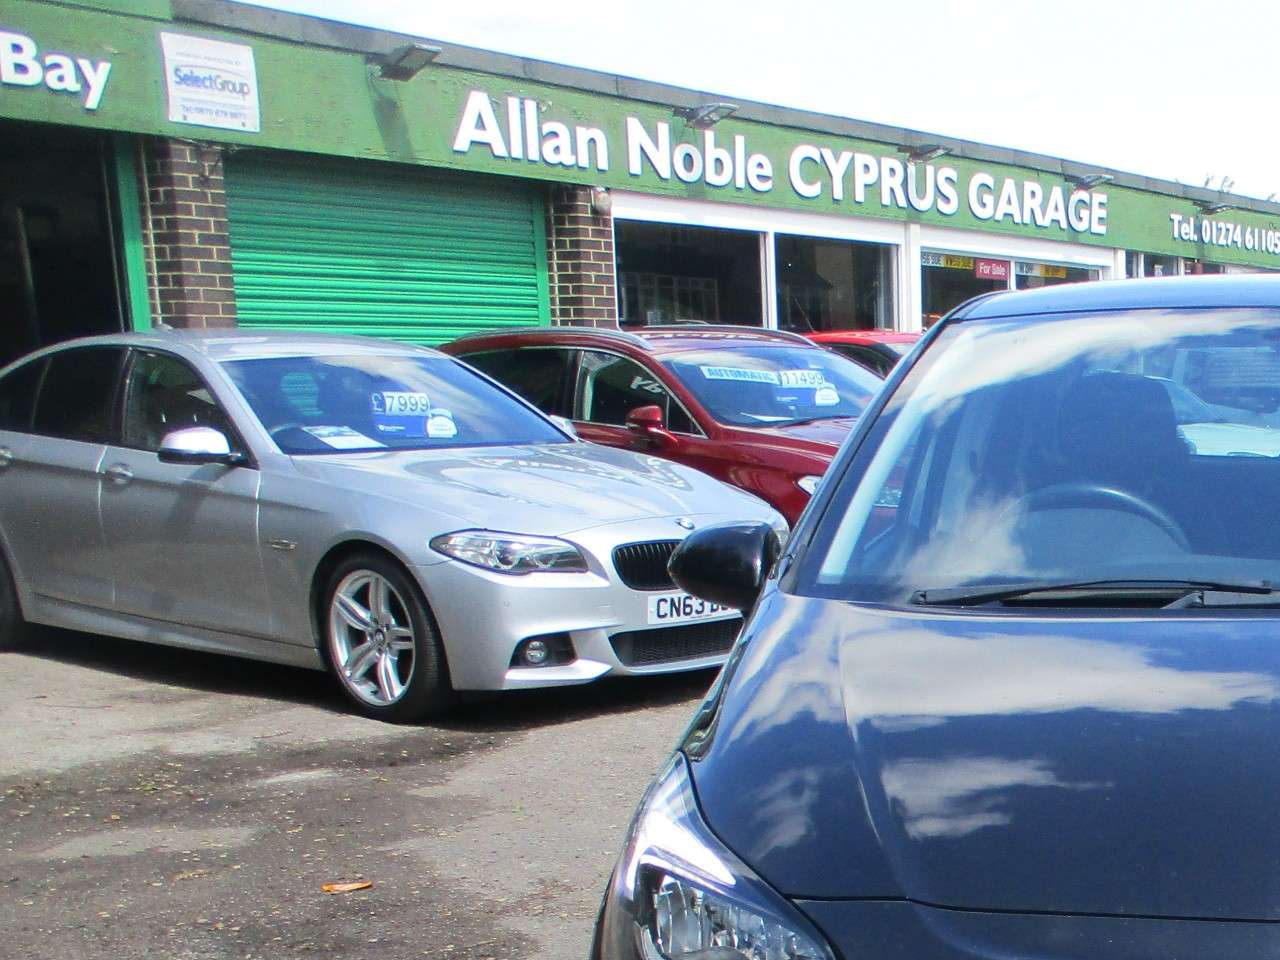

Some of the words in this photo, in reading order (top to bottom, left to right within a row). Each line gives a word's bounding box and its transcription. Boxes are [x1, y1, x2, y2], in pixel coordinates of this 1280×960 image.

[0, 31, 111, 110] Bay
[174, 67, 250, 99] SelectGroup
[452, 90, 609, 172] Allan
[626, 116, 774, 192] Noble
[789, 144, 959, 215] CYPRUS
[967, 172, 1108, 235] GARAGE
[1170, 213, 1198, 241] Tel.
[1201, 219, 1242, 249] 01274
[979, 262, 991, 274] For
[992, 263, 1006, 276] Sale
[707, 367, 775, 383] AUTOMATIC
[656, 596, 704, 618] CN63
